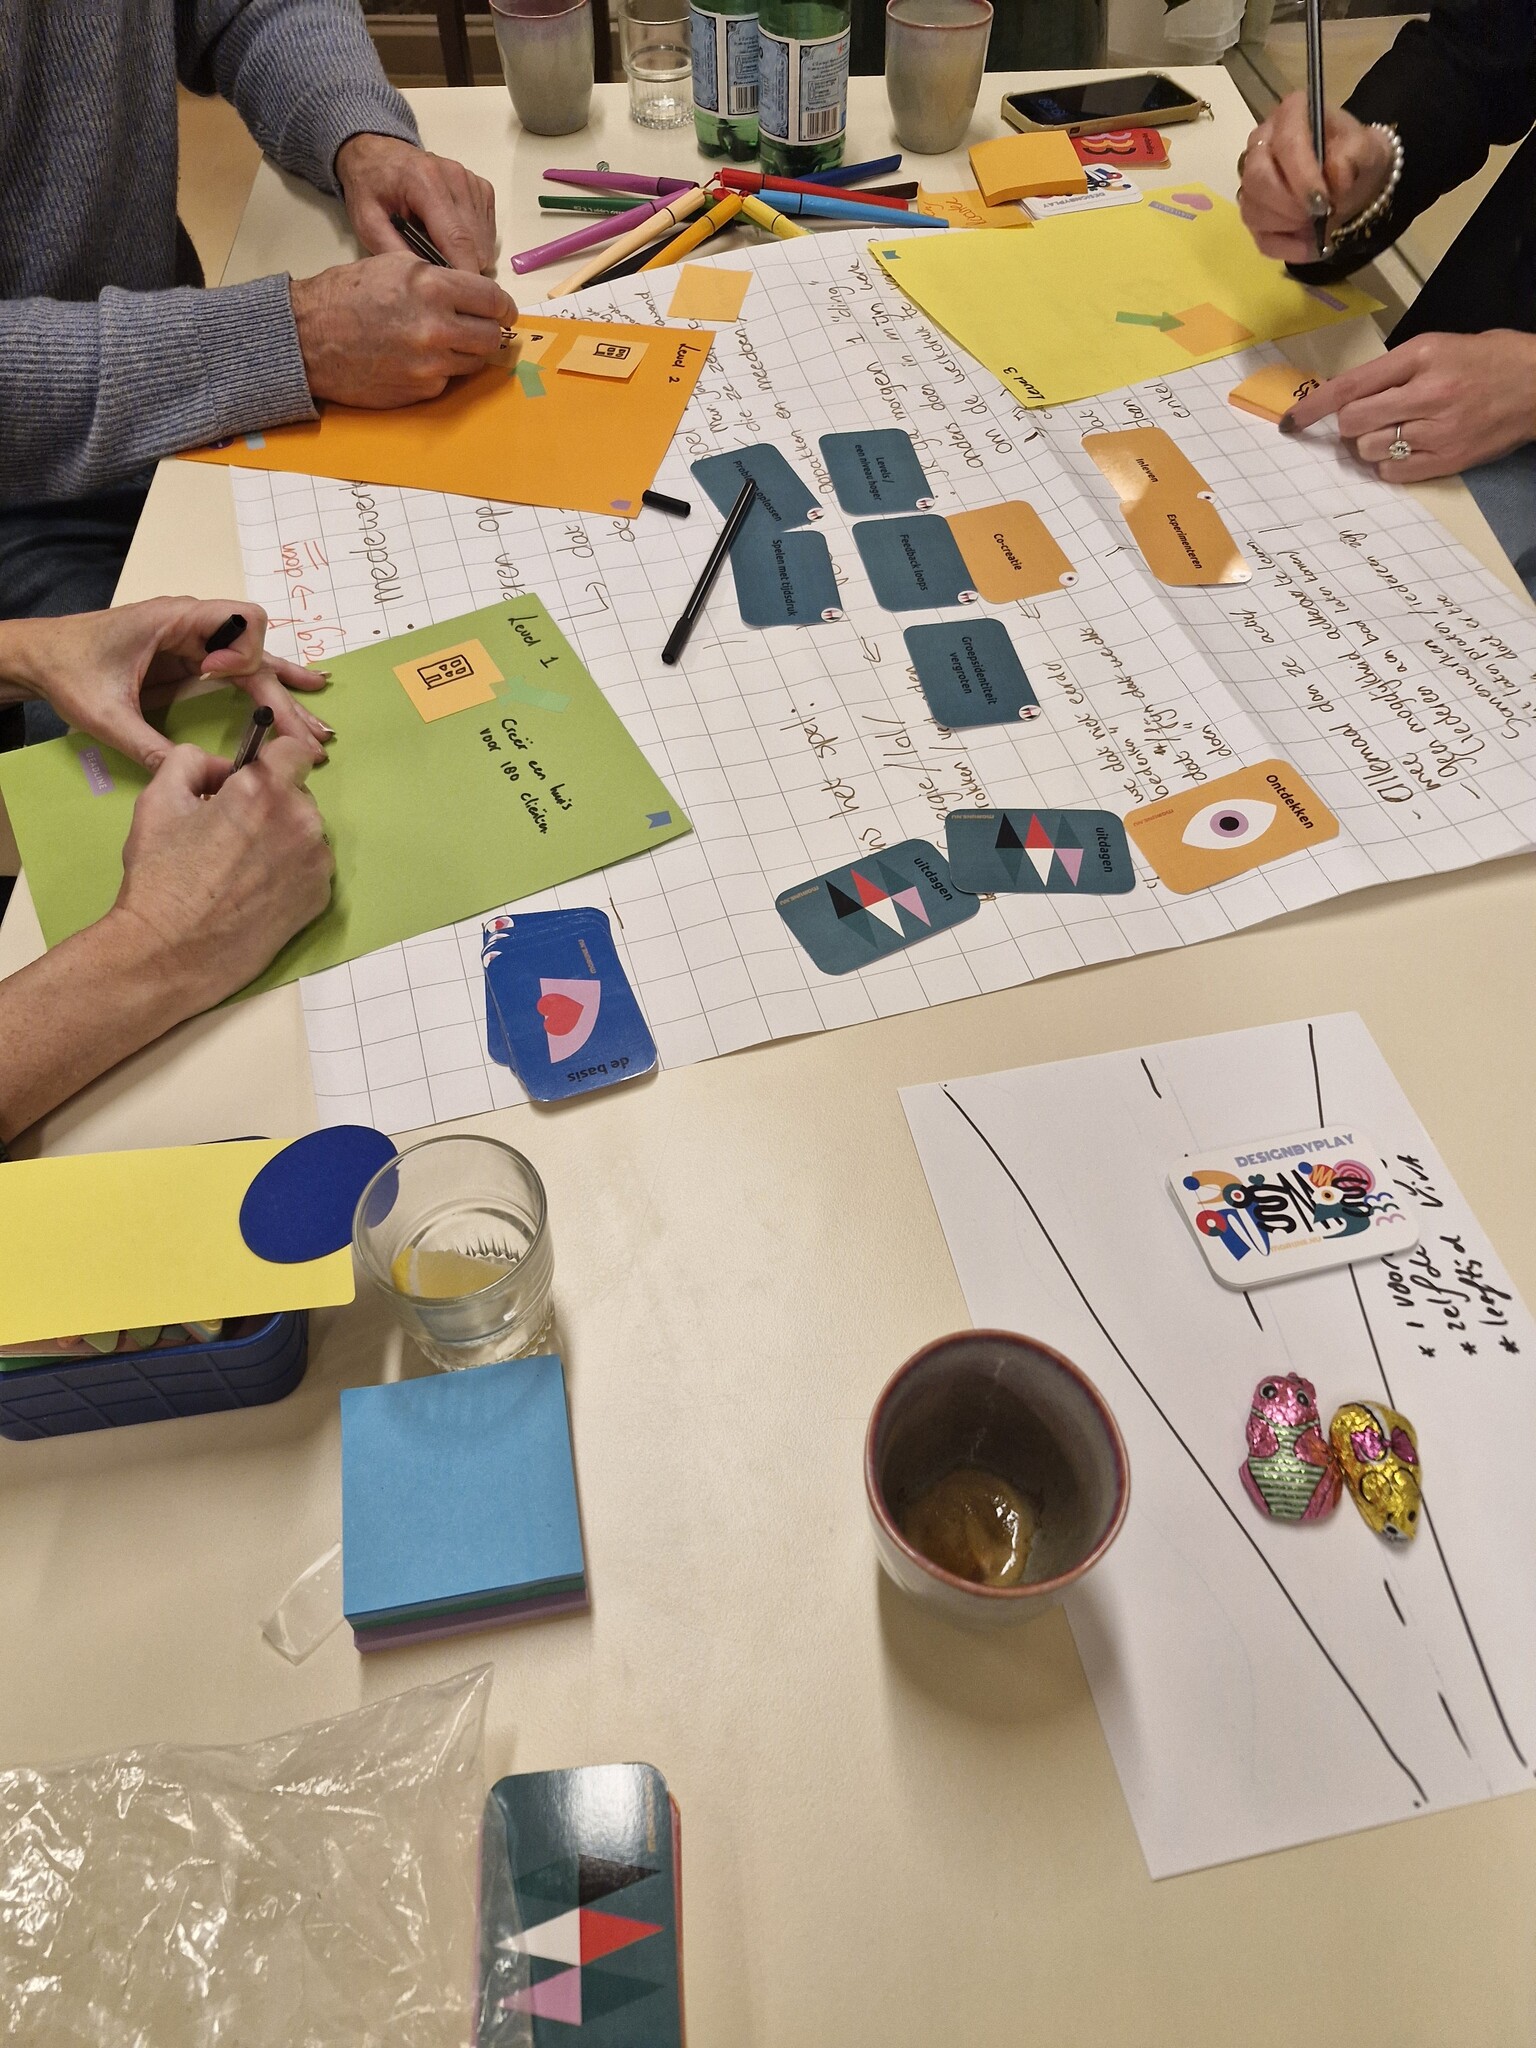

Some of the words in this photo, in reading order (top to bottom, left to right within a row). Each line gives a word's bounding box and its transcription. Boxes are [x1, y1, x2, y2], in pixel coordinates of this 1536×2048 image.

[900, 302, 918, 321] te
[672, 343, 702, 369] Level
[901, 354, 919, 367] in
[668, 376, 680, 384] 2
[1003, 366, 1018, 375] 3
[722, 383, 742, 401] ze
[866, 361, 908, 422] morgen
[920, 384, 946, 411] doen
[1013, 376, 1046, 400] Level
[774, 401, 792, 420] en
[961, 394, 988, 415] de
[945, 422, 983, 468] anders
[985, 428, 1013, 454] om
[855, 444, 864, 458] een
[860, 457, 874, 482] niveau
[869, 480, 882, 501] hoger
[876, 457, 890, 480] Levels
[1135, 458, 1159, 483] Inleven
[476, 505, 513, 533] op
[756, 491, 782, 522] oplossen
[557, 524, 594, 558] dat
[773, 539, 784, 565] Spelen
[993, 533, 1022, 571] Co-creatie
[1167, 513, 1203, 569] Experimenteren
[778, 565, 789, 584] met
[901, 534, 921, 569] Feedback
[914, 567, 928, 591] loops
[782, 581, 798, 617] tijdsdruk
[1319, 586, 1350, 614] laten
[508, 615, 541, 647] Level
[540, 656, 559, 669] 1
[1347, 620, 1380, 647] bod
[1434, 621, 1489, 661] praten
[1480, 635, 1518, 661] doet
[950, 652, 972, 694] vergroten
[962, 636, 998, 705] Groepsidentiteit
[1282, 655, 1305, 678] ze
[1486, 663, 1522, 698] laten
[1075, 713, 1106, 741] niet
[480, 728, 502, 752] voor
[500, 761, 520, 782] 180
[1096, 746, 1125, 772] dat
[1173, 751, 1207, 781] dat
[85, 752, 107, 791] DEADLINE
[528, 760, 546, 781] een
[821, 778, 860, 820] het
[1266, 774, 1314, 829] Ontdekken
[1096, 827, 1113, 873] uitdagen
[914, 857, 953, 901] uitdagen
[568, 1064, 608, 1083] basis
[611, 1056, 630, 1070] de
[1234, 1133, 1356, 1169] DESIGNBYPLAY
